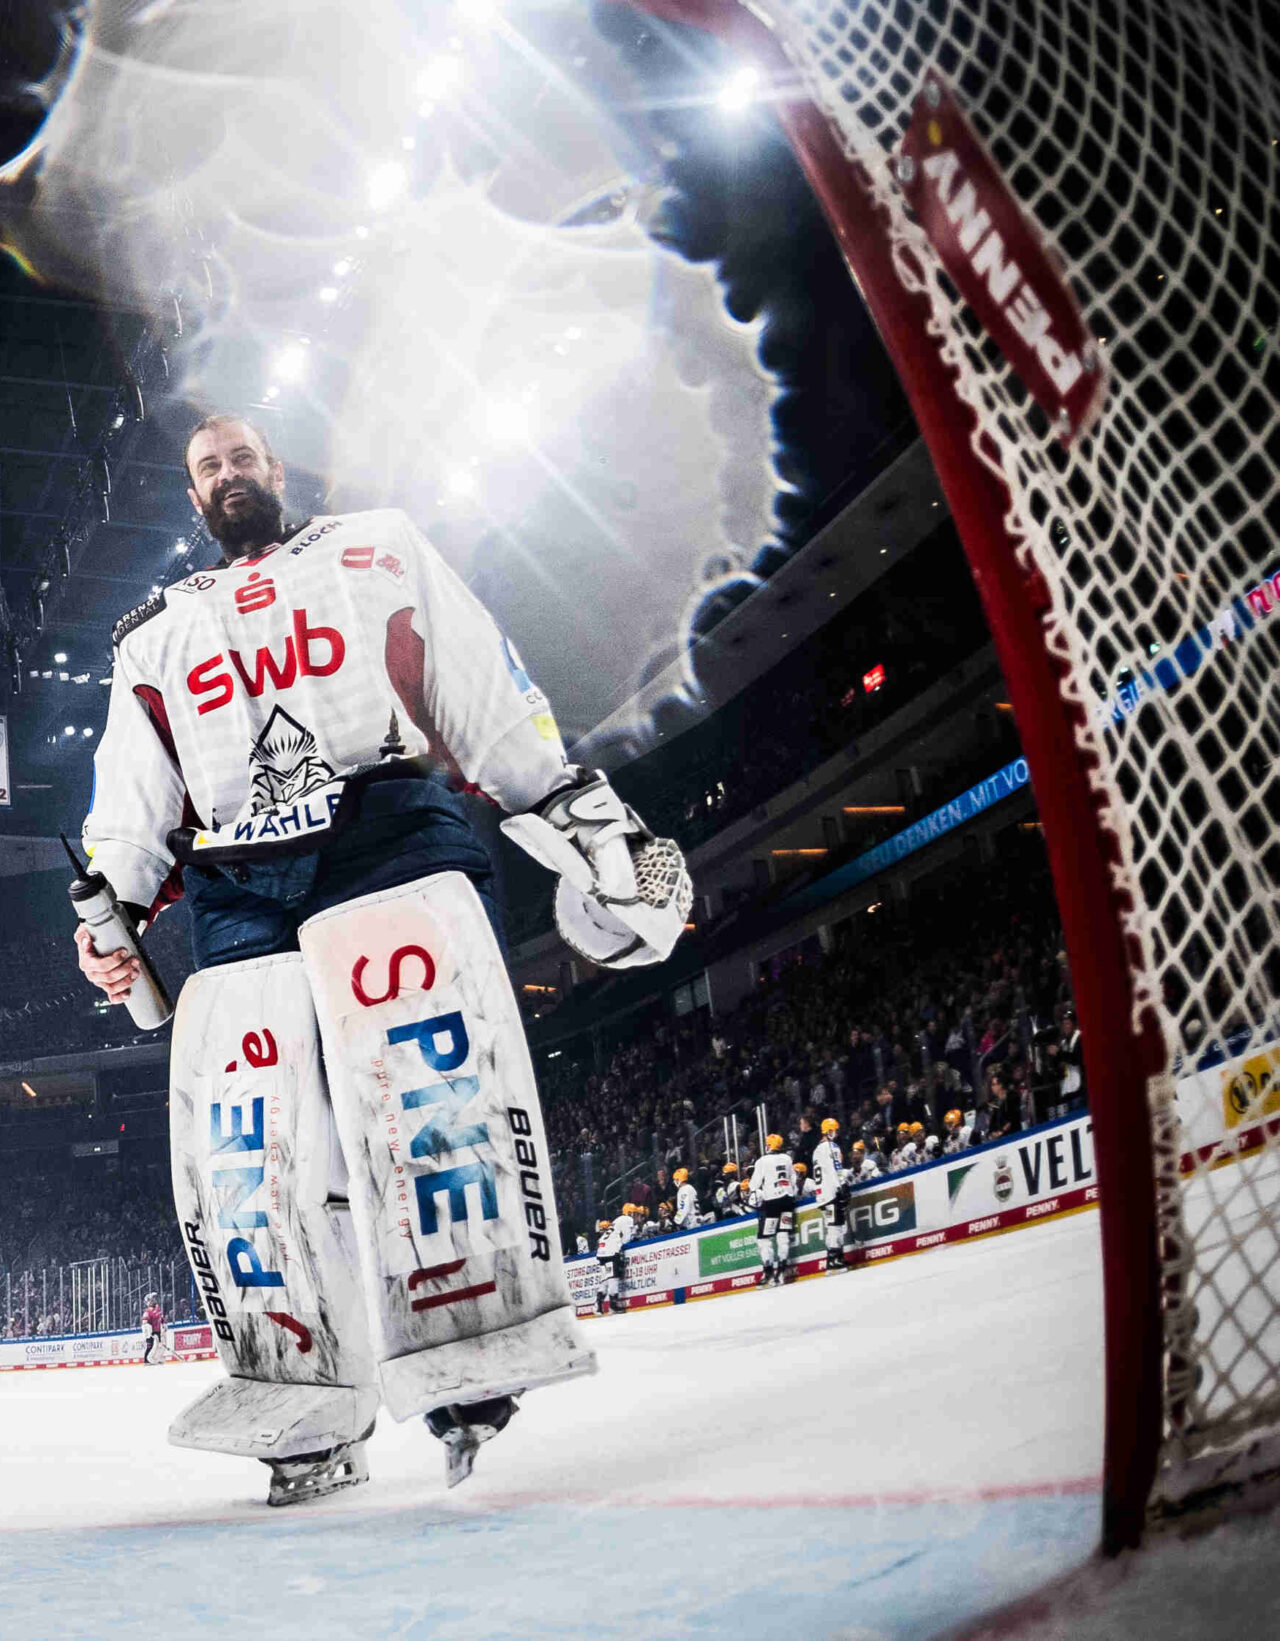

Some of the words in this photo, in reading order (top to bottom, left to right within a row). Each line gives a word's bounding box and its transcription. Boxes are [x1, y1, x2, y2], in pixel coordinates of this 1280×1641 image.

[291, 520, 343, 556] BLOCH
[186, 608, 346, 716] swb
[970, 774, 1000, 808] MIT
[270, 1095, 281, 1162] energy
[386, 1010, 500, 1236] PNE
[210, 1096, 287, 1288] PNE
[270, 1175, 280, 1211] new
[384, 1112, 400, 1153] new
[393, 1165, 412, 1240] energy
[25, 1343, 65, 1355] CONTIPARK
